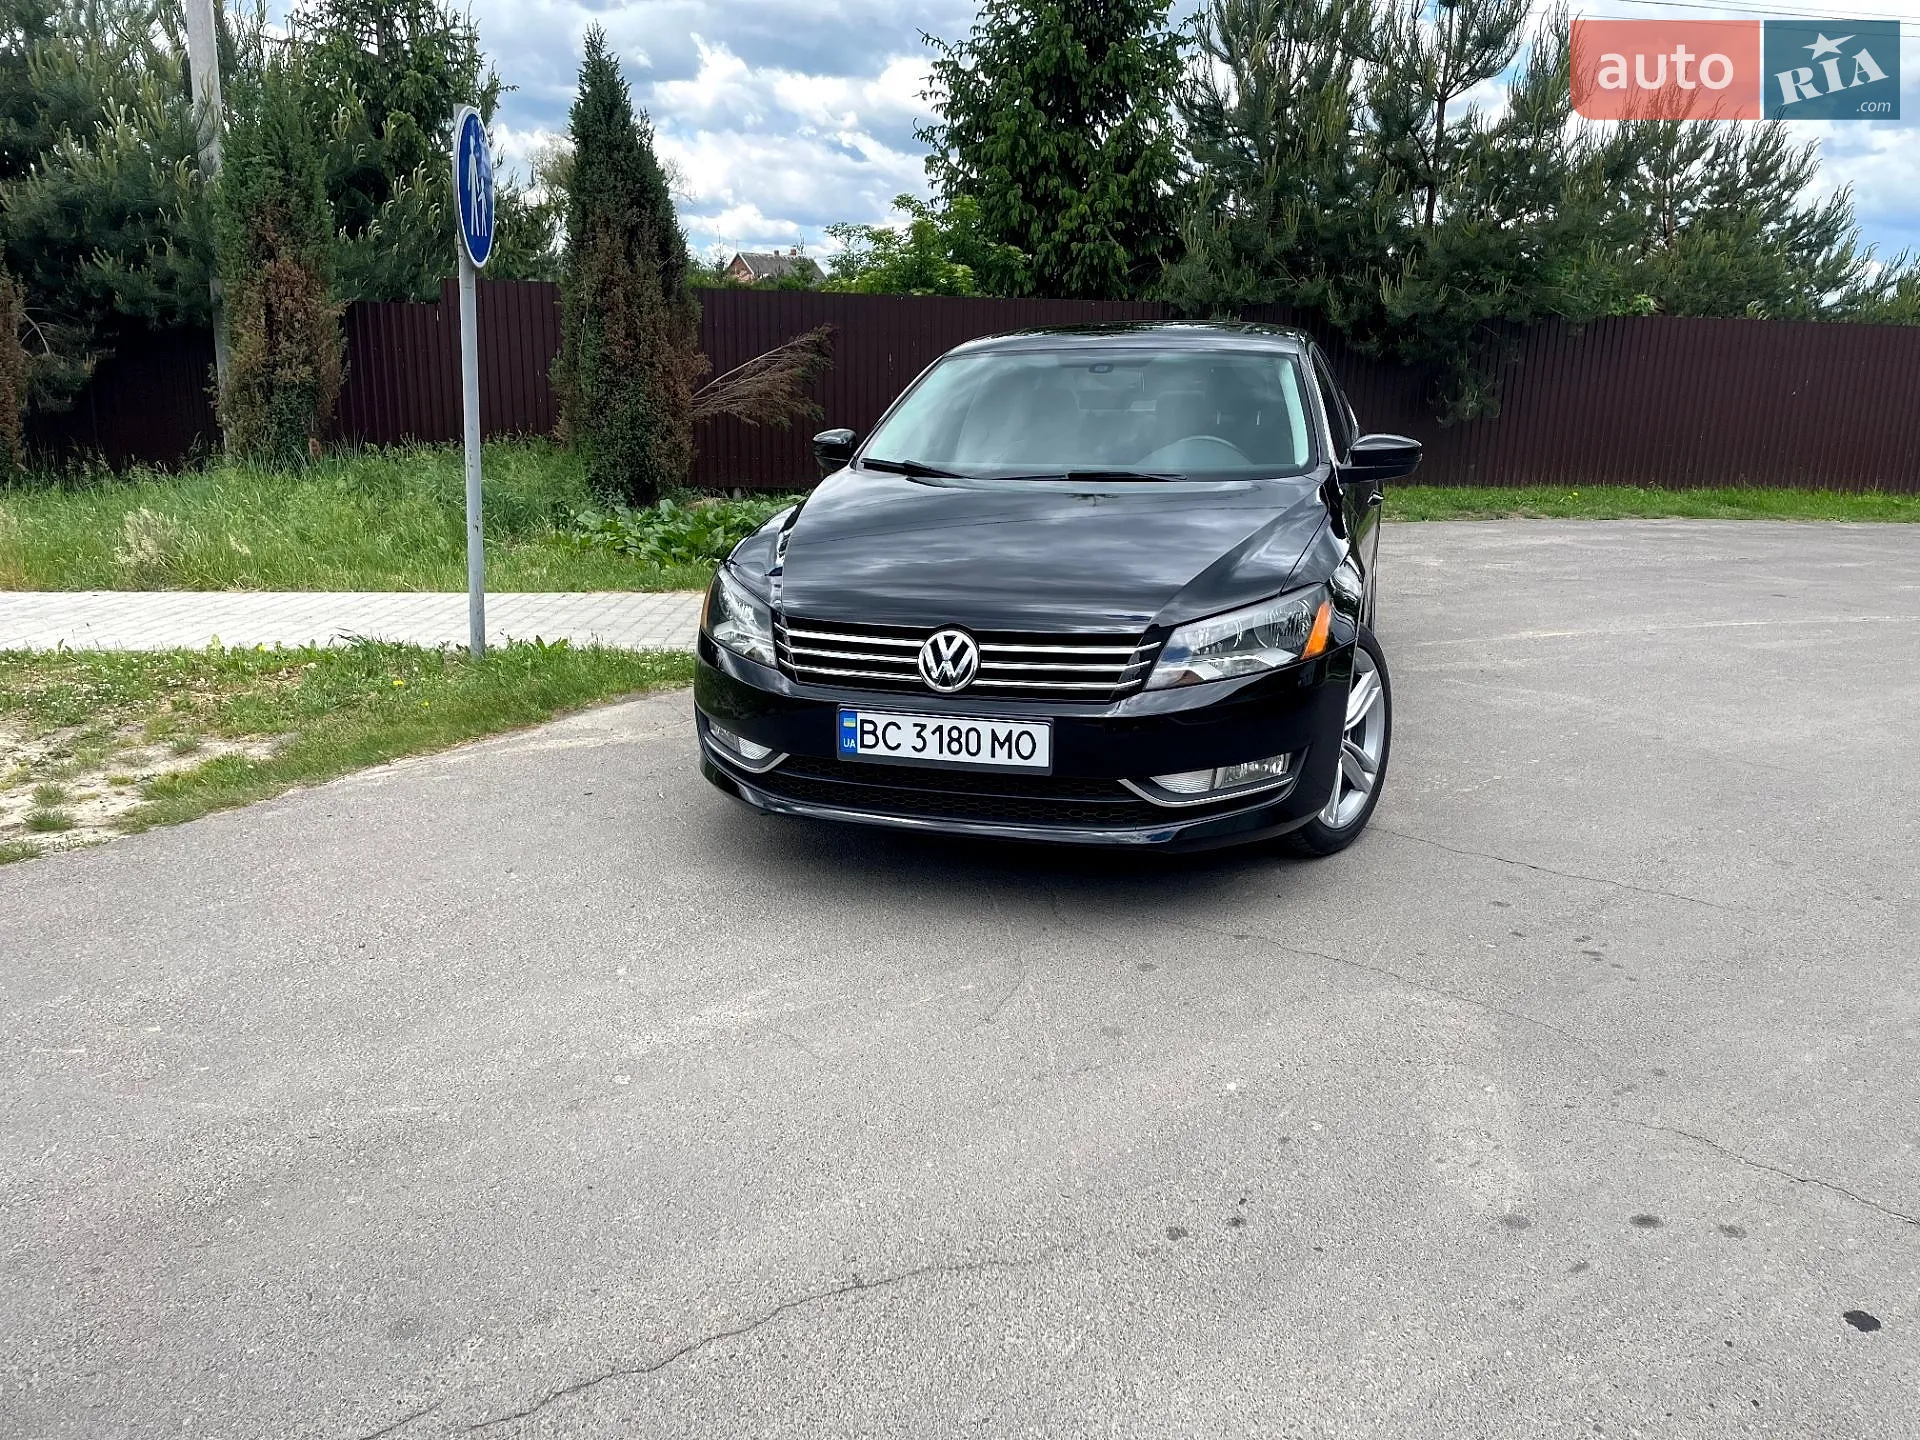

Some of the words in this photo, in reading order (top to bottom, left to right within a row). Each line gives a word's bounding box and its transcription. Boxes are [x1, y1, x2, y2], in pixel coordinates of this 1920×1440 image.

[843, 737, 856, 748] UA
[859, 718, 902, 751] BC
[911, 722, 982, 757] 3180
[990, 728, 1036, 760] MO
